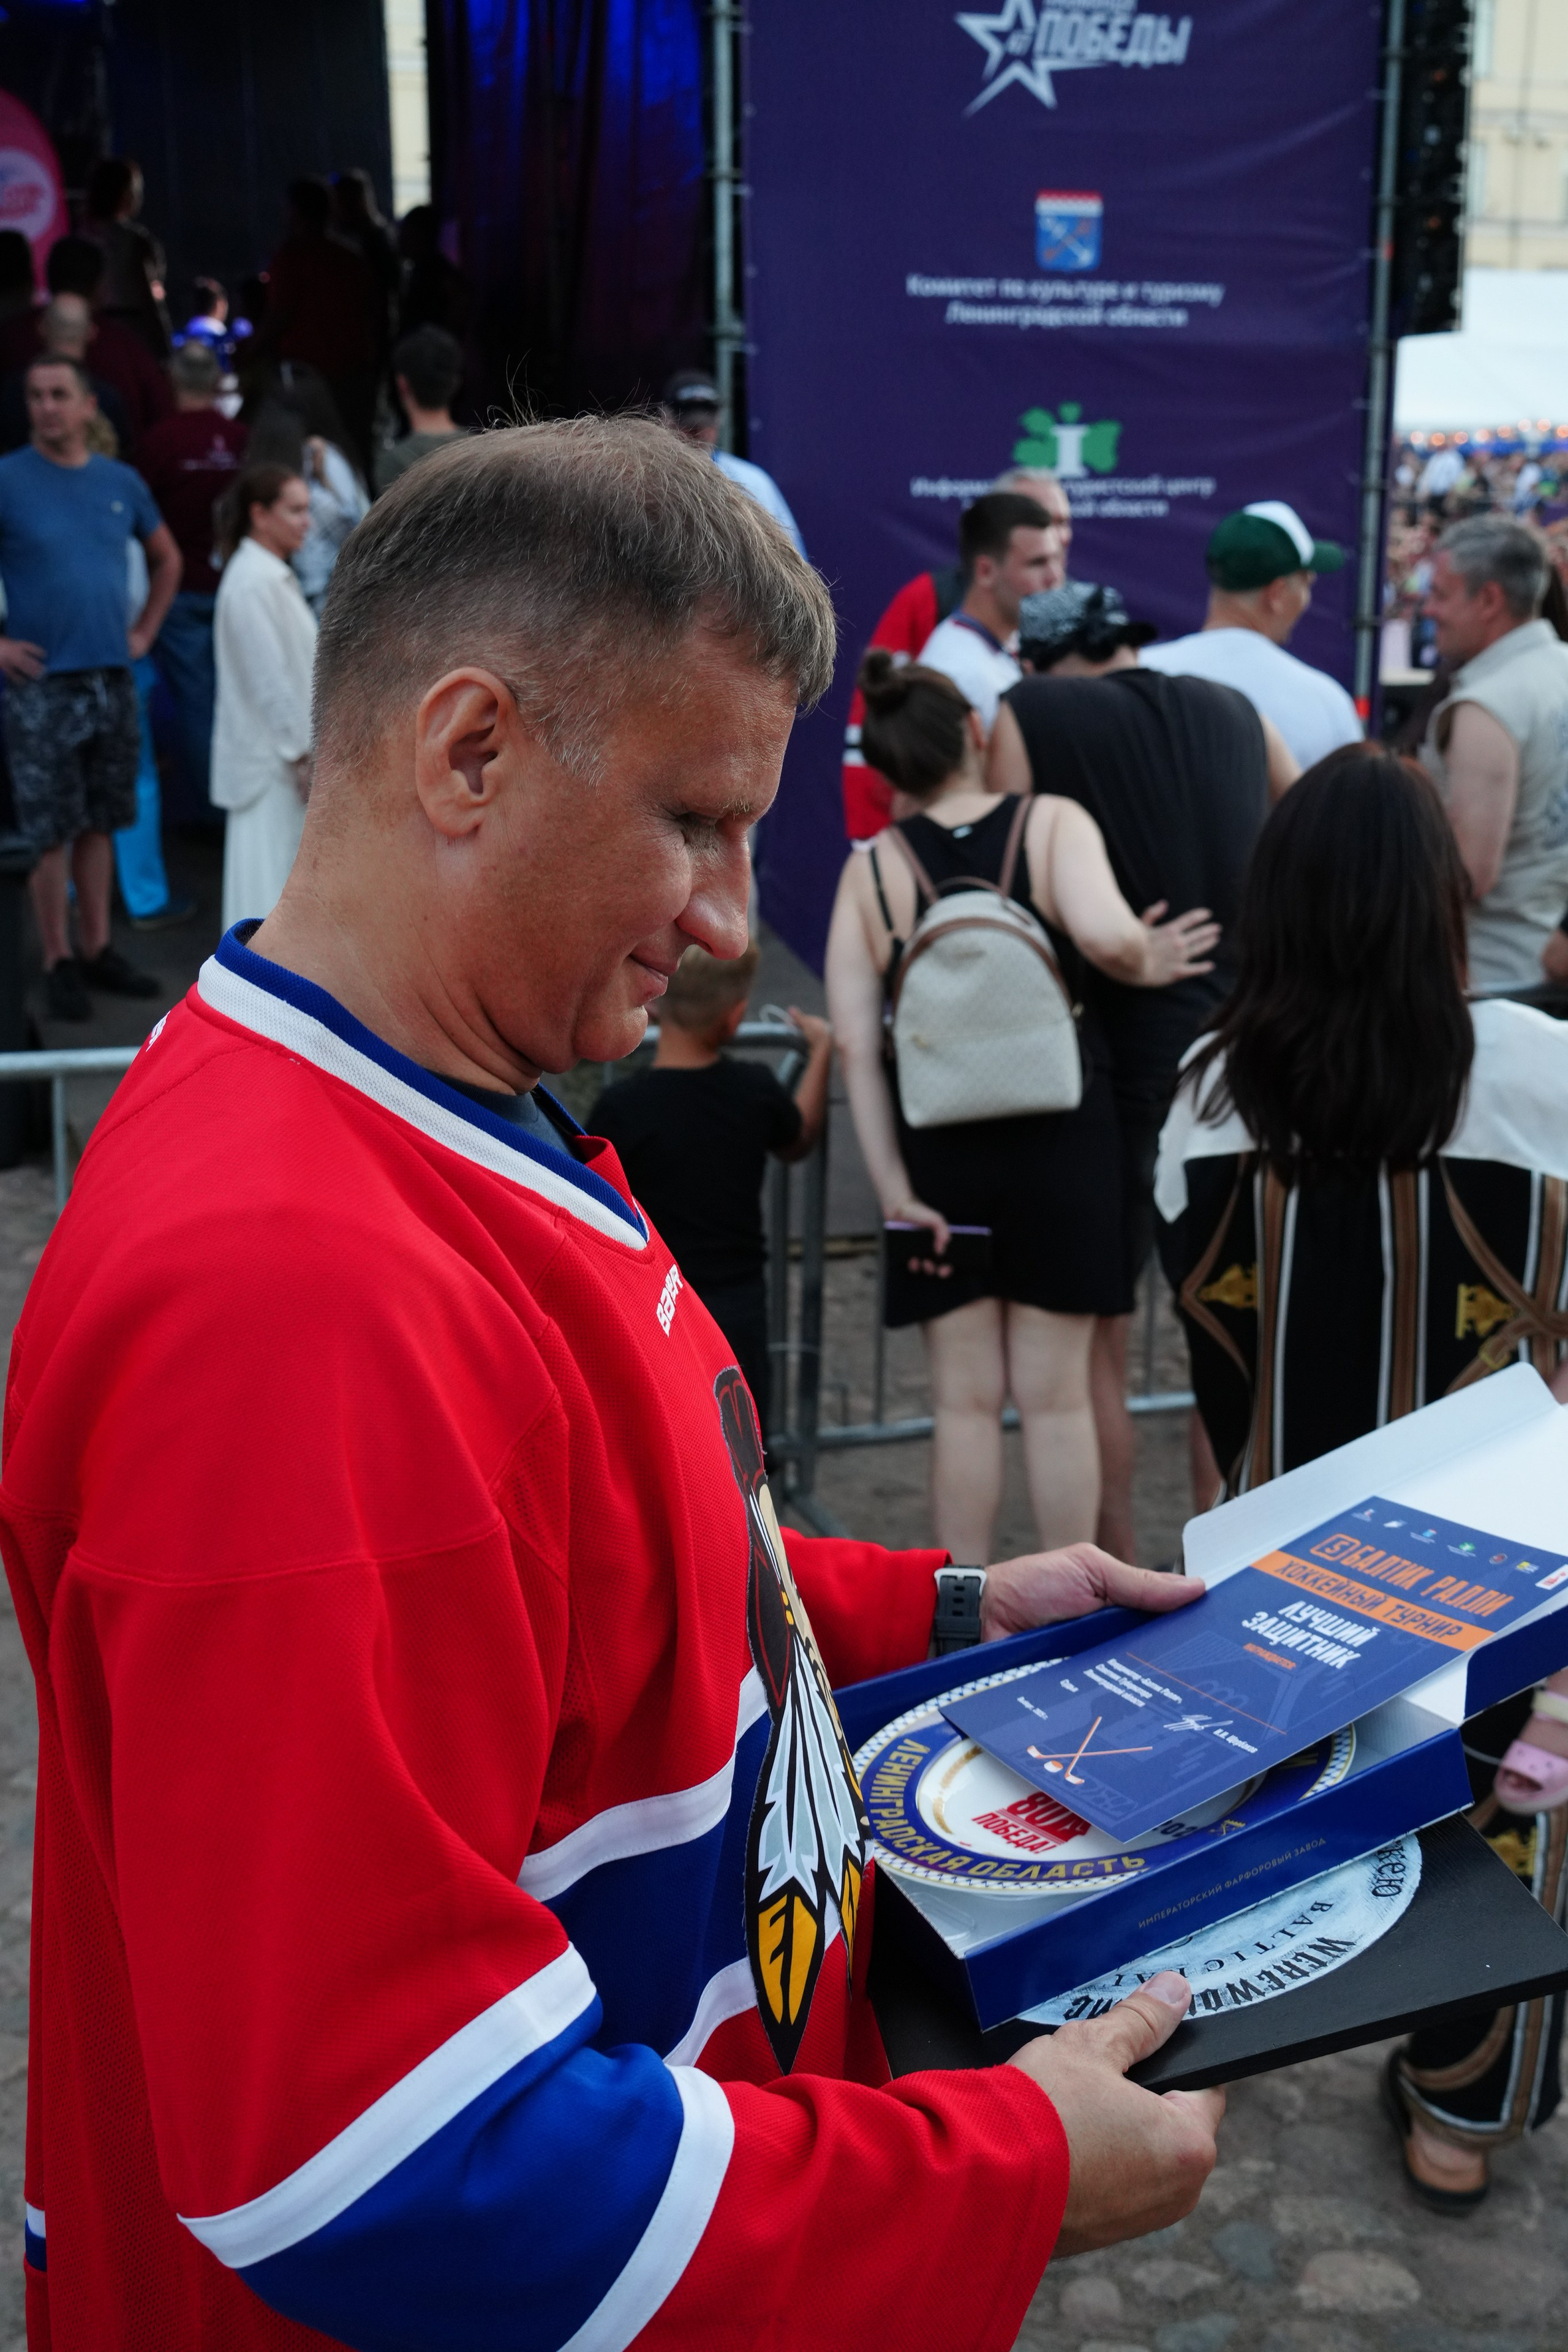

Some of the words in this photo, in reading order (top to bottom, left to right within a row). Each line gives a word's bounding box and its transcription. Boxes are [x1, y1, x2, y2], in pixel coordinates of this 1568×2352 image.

[1034, 11, 1193, 69] ПОБЕДЫ
[1274, 1559, 1390, 1612] ХОККЕЙНЫЙ
[1382, 1603, 1464, 1639] ТУРНИР
[1340, 1544, 1435, 1591] БАЛТИК
[1420, 1575, 1515, 1618] РАЛЛИ
[1241, 1611, 1362, 1670] ЗАЩИТНИК
[1277, 1600, 1381, 1648] ЛУЧШИЙ
[869, 1738, 973, 1872] ЛЕНИНГРАДСКАЯ
[967, 1856, 1147, 1880] ОБЛАСТЬ
[971, 1811, 1060, 1855] ПОБЕДА!
[1137, 1883, 1223, 1929] ИМПЕРАТОРСКИЙ
[1224, 1850, 1292, 1888] ФАРФОРОВЫЙ
[1294, 1837, 1327, 1858] ЗАВОД
[1204, 1900, 1334, 1972] BALTIC
[1187, 1937, 1356, 2018] WEREWO
